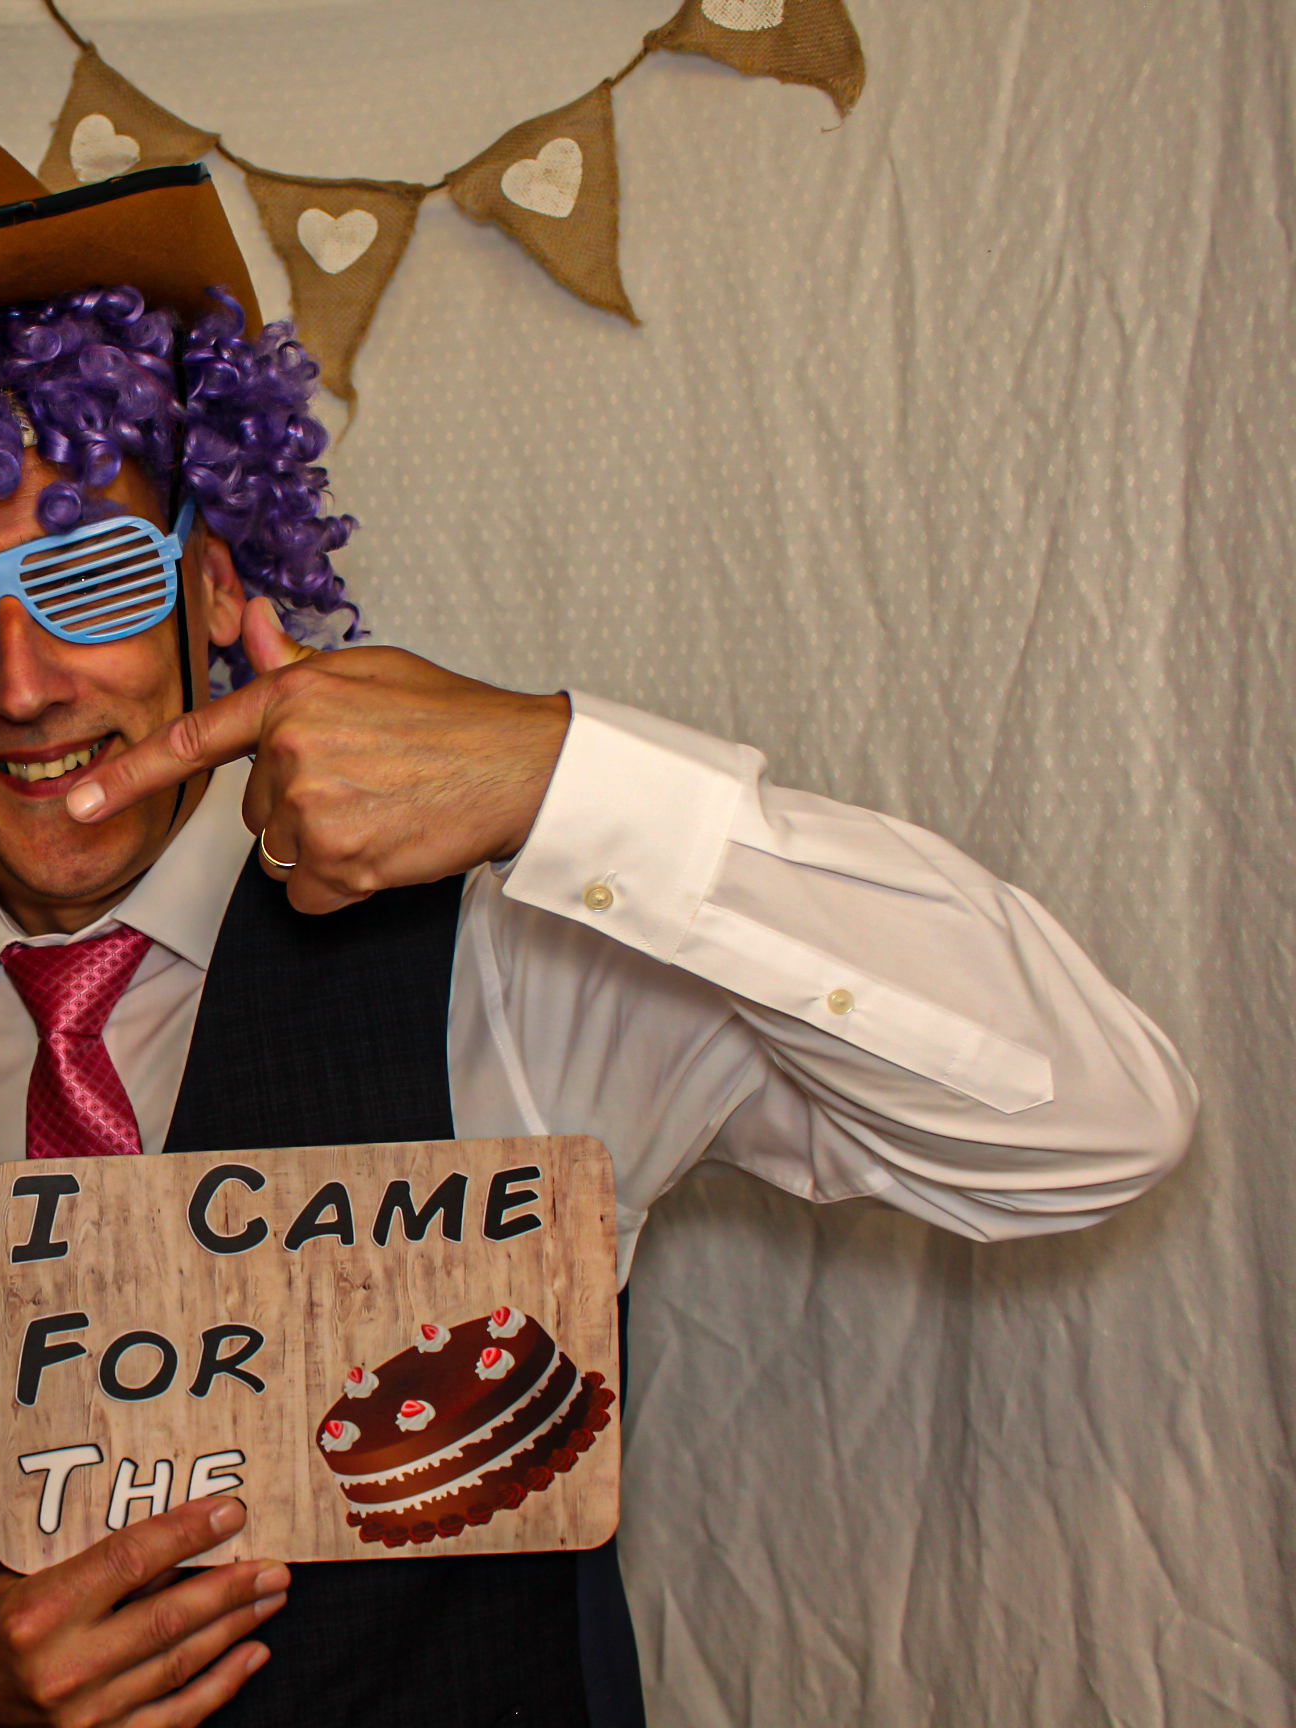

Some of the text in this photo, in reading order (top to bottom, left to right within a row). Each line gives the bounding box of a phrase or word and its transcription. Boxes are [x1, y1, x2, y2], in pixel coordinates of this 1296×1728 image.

[10, 1163, 543, 1264] I CAME
[14, 1311, 266, 1407] FOR
